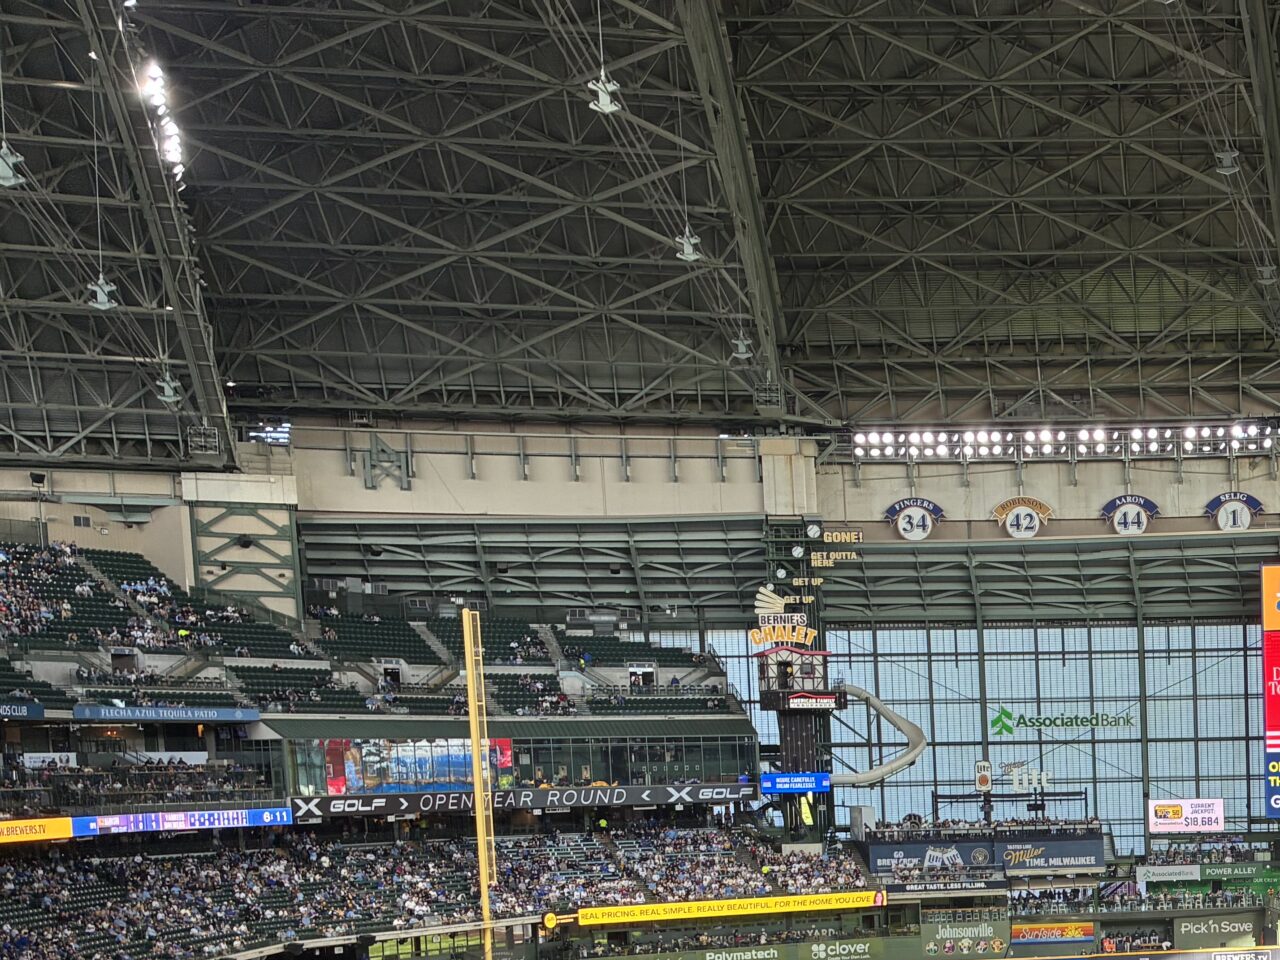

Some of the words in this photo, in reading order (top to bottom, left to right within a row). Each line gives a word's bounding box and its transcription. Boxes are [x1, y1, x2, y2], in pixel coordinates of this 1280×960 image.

[1114, 495, 1145, 506] AARON
[1219, 492, 1247, 502] SELIG
[893, 499, 934, 511] FINGERS
[999, 497, 1044, 511] ROBINSON
[901, 514, 929, 532] 34
[1009, 513, 1037, 532] 42
[1116, 511, 1144, 529] 44
[823, 531, 863, 543] GONE!
[811, 552, 827, 560] GET
[829, 551, 857, 560] OUTTA
[811, 560, 835, 568] HERE
[792, 578, 808, 586] GET
[810, 578, 824, 586] UP
[784, 596, 800, 604] GET
[802, 596, 815, 604] UP
[760, 614, 806, 626] BERNIE'S
[750, 625, 818, 646] CHALET
[101, 709, 132, 717] FLECHA
[135, 709, 156, 717] AZUL
[159, 709, 192, 718] TEQUILA
[194, 710, 217, 718] PATIO
[330, 798, 387, 812] GOLF
[420, 793, 475, 812] OPEN
[484, 790, 532, 809] YEAR
[546, 787, 627, 806] ROUND
[698, 786, 754, 801] GOLF
[263, 811, 287, 823] 6:11
[1184, 817, 1220, 828] $18,684
[1206, 868, 1231, 876] POWER
[1232, 866, 1257, 875] ALLEY
[581, 910, 599, 920] REAL
[601, 908, 637, 919] PRICING.
[640, 907, 660, 917] REAL
[663, 906, 695, 916] SIMPLE.
[697, 903, 725, 914] REALLY
[727, 902, 773, 912] BEAUTIFUL.
[774, 900, 790, 909] FOR
[792, 899, 808, 908] THE
[809, 898, 833, 907] HOME
[835, 896, 851, 905] YOU
[852, 895, 871, 904] LOVE
[935, 923, 993, 940] Johnsonville
[1019, 927, 1062, 940] Surfside
[827, 941, 871, 957] clover
